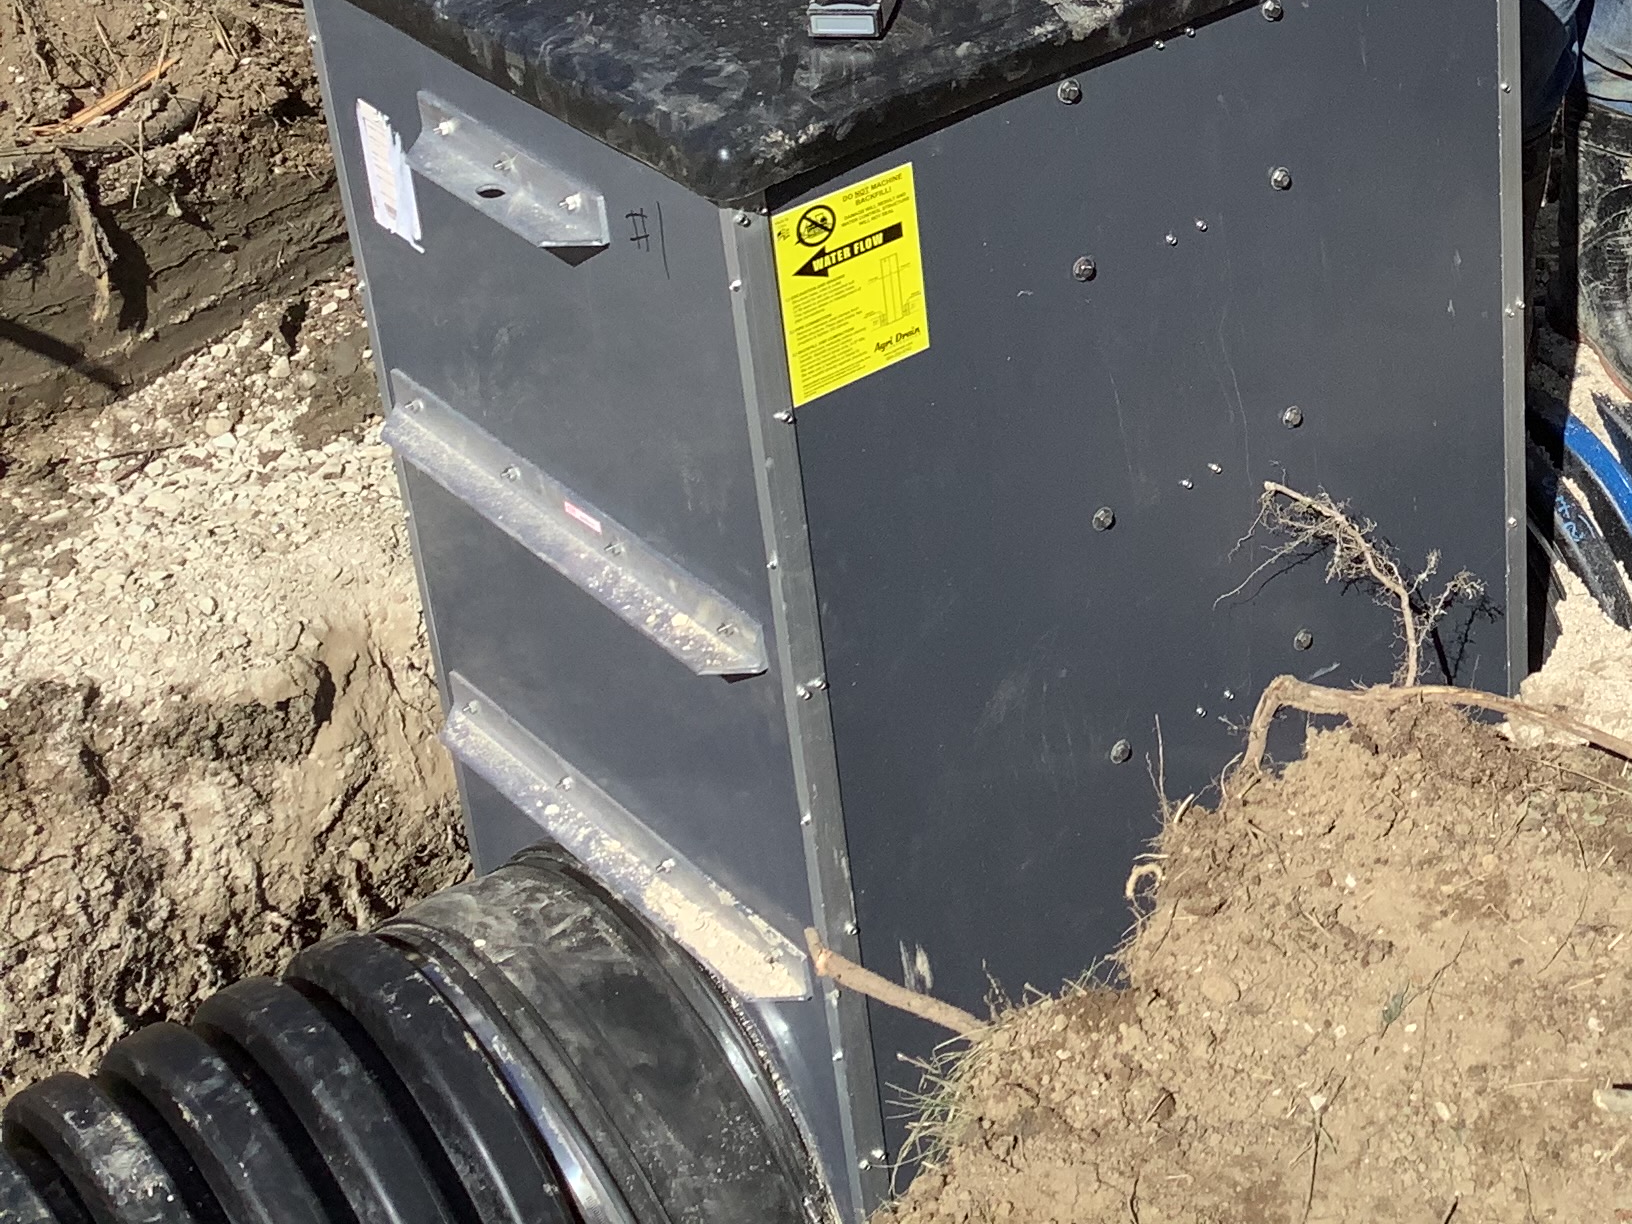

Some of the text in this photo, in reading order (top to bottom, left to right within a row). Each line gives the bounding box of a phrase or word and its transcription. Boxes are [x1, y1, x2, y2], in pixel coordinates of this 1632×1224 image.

[842, 172, 903, 203] DO NOT MACHINE
[855, 185, 892, 206] BACKFILL!
[625, 200, 671, 281] #1
[811, 231, 884, 273] WATER FLOW
[873, 335, 894, 353] Agri
[895, 325, 921, 343] Drain
